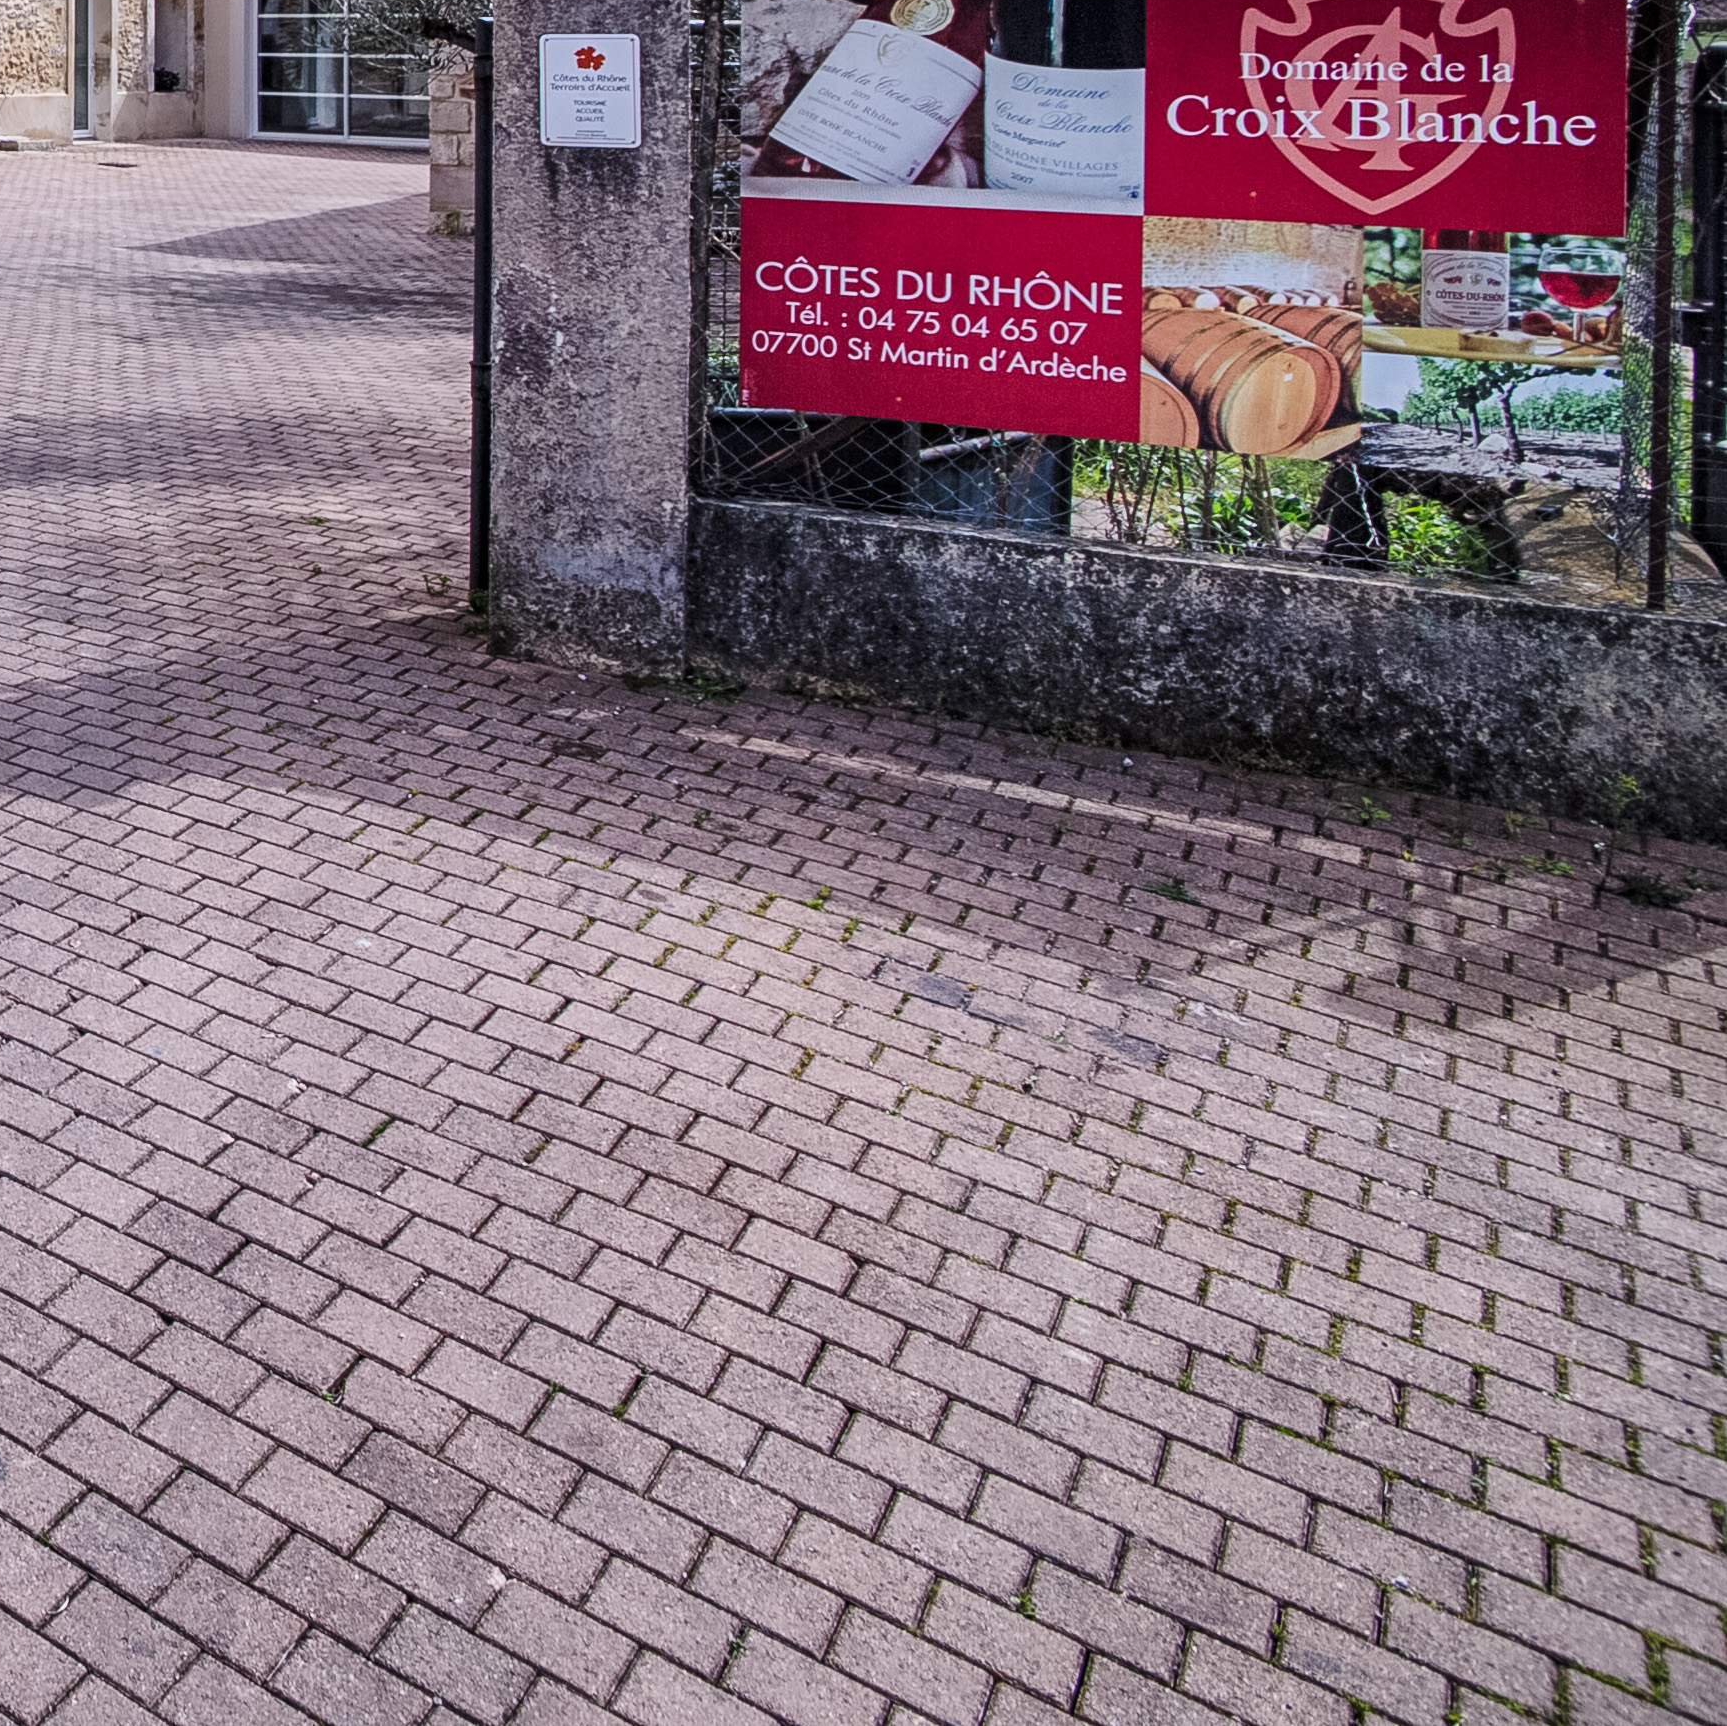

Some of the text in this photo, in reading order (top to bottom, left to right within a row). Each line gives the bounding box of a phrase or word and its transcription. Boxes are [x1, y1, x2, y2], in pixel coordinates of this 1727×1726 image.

[553, 74, 627, 83] Côtes du Rhône
[1239, 52, 1514, 83] Domaine de la
[549, 82, 630, 92] Terroirs d'Accueil
[1010, 71, 1113, 100] Domaine
[575, 115, 605, 123] QUALITÉ
[844, 98, 859, 110] du
[862, 105, 899, 128] Rhône
[910, 95, 957, 128] Blanch
[995, 99, 1134, 134] Croix Blanche
[1166, 94, 1597, 147] Croix Blanche
[1010, 171, 1034, 184] 2007
[1052, 157, 1119, 171] VILLAGES
[755, 255, 1123, 315] CÔTES DU RHÔNE
[785, 300, 829, 327] Tél.
[858, 306, 895, 331] 04
[905, 310, 941, 334] 75
[951, 313, 990, 338] 04
[1000, 317, 1038, 342] 65
[1049, 320, 1088, 345] 07
[751, 330, 1127, 383] 07700 St Martin d'Ardèche
